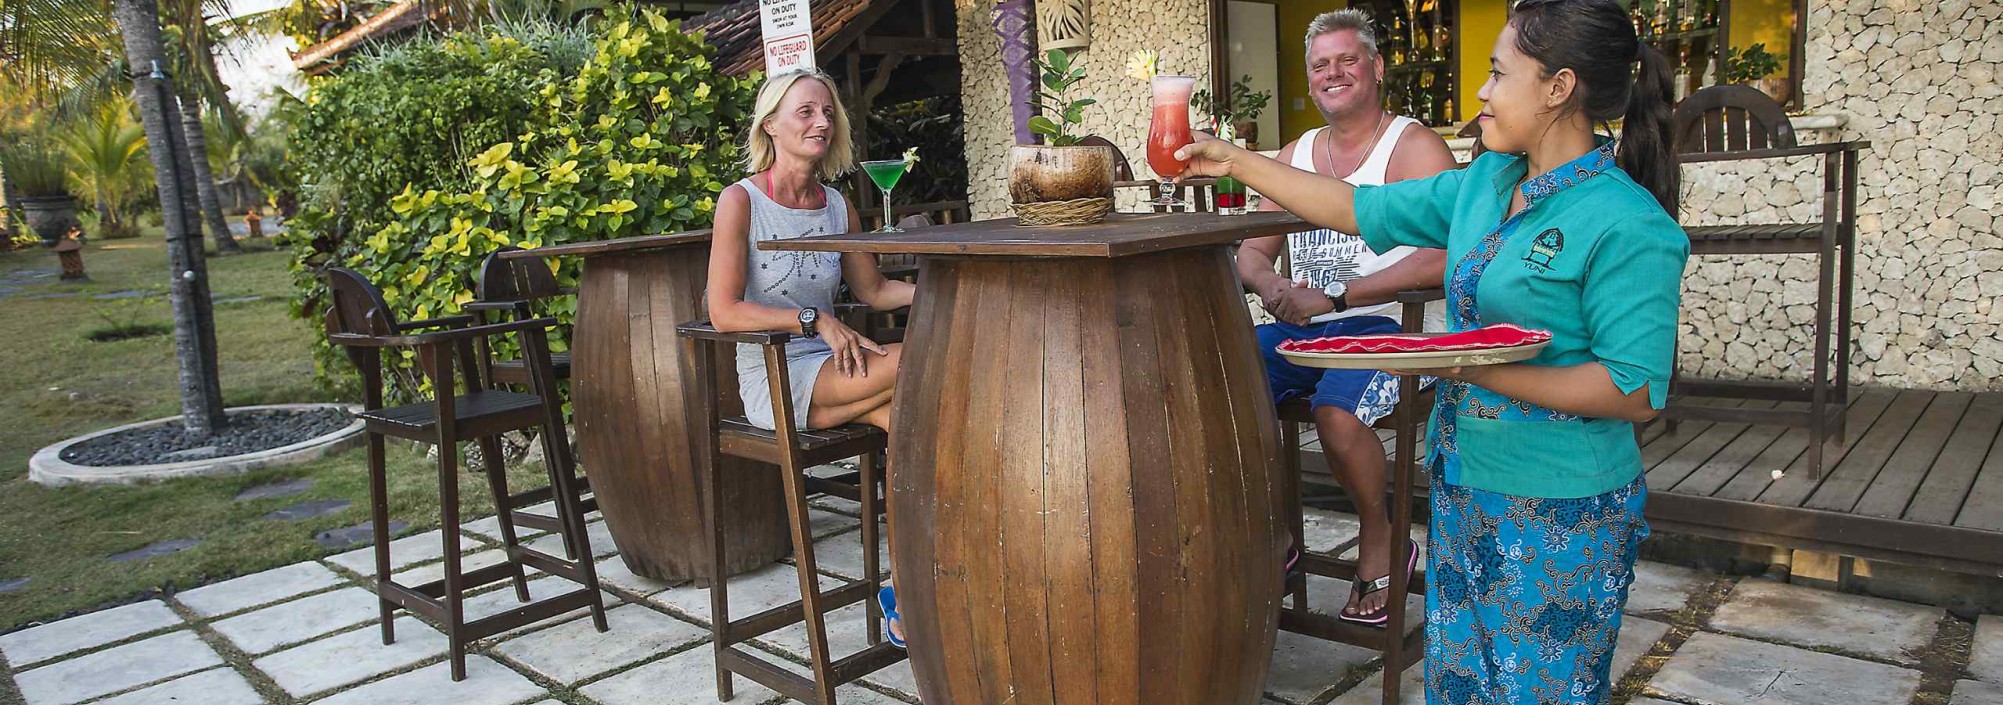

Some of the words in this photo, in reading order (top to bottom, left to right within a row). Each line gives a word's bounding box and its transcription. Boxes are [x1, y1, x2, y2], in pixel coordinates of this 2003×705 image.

[781, 3, 796, 13] DUTY
[770, 46, 778, 57] NO
[778, 40, 807, 56] LIFEGUARD
[778, 57, 786, 67] ON
[786, 54, 800, 65] DUTY
